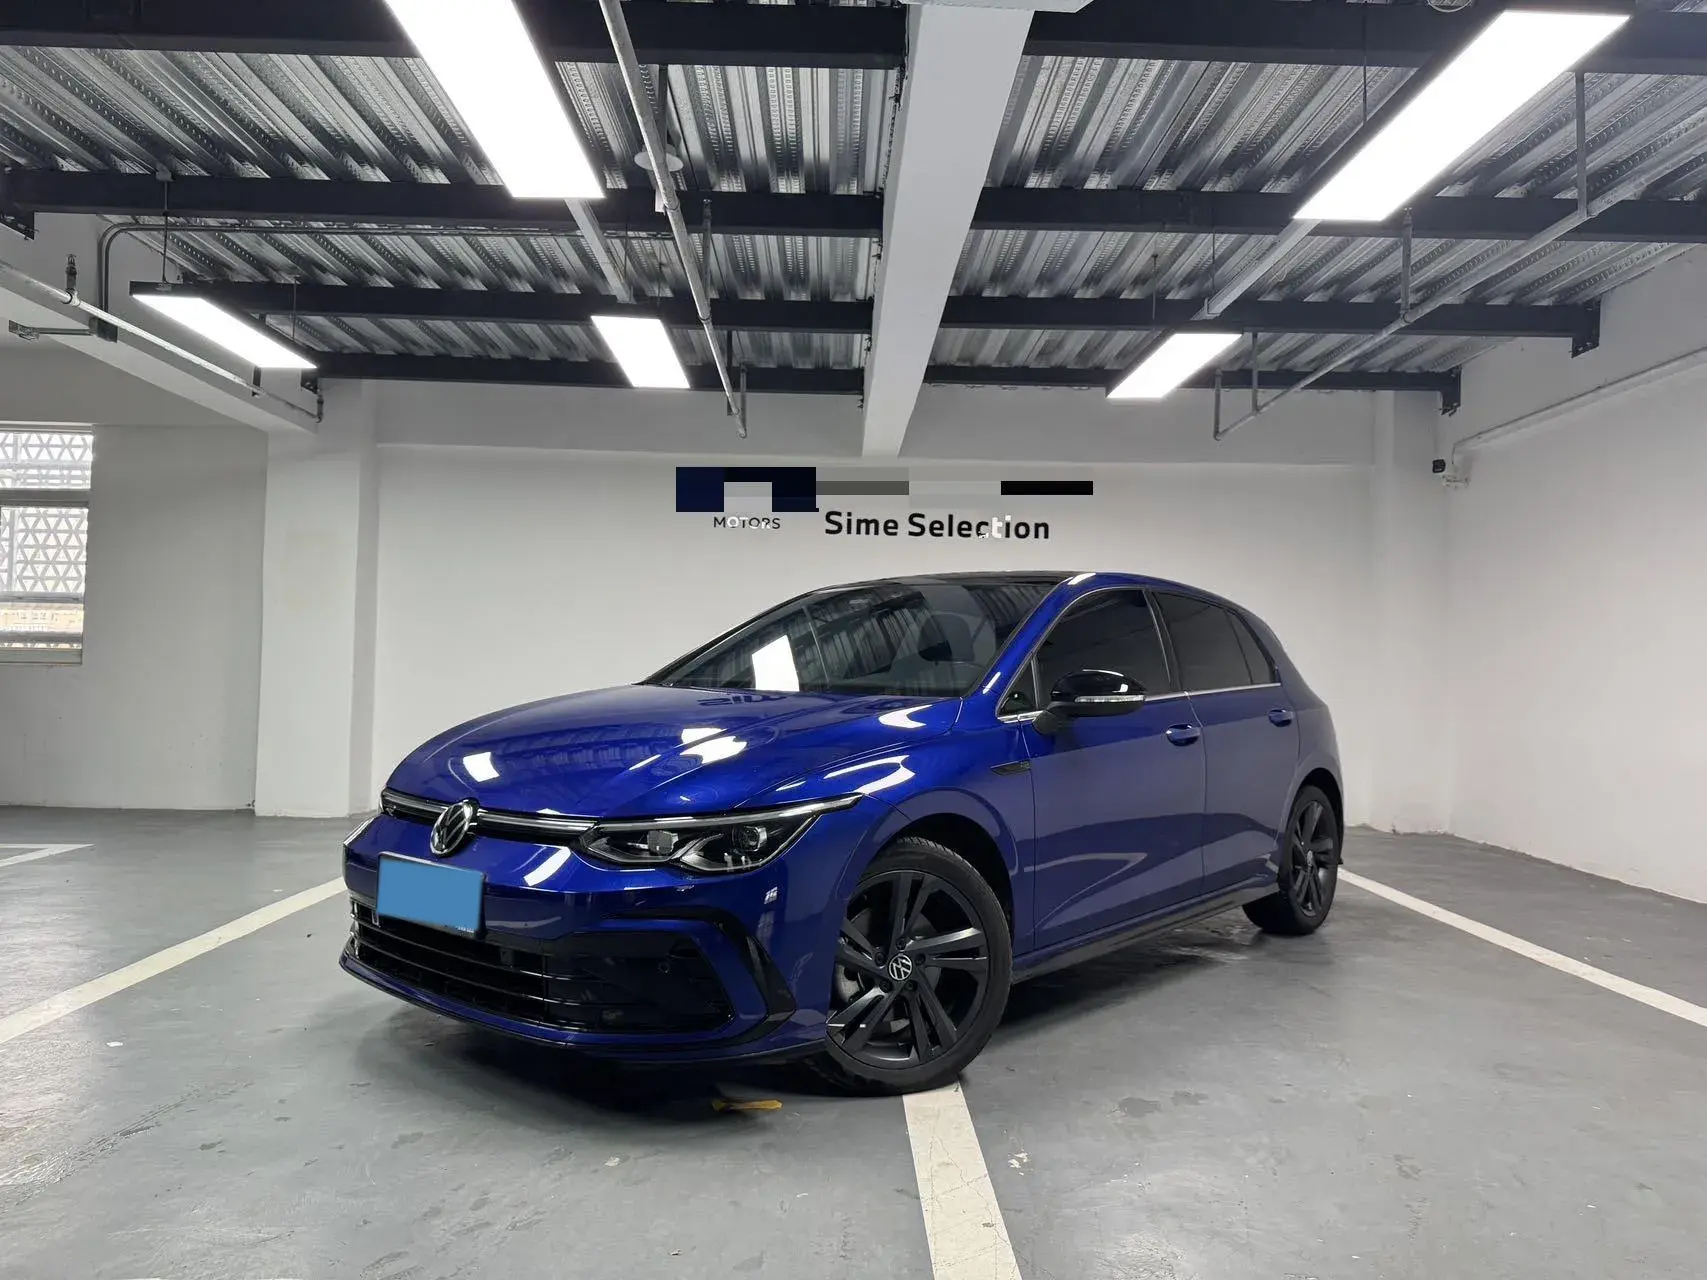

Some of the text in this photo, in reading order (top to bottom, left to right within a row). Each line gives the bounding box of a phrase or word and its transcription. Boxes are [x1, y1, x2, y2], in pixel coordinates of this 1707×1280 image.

[713, 516, 781, 530] MOTORS
[824, 510, 1050, 539] Sime Selection
